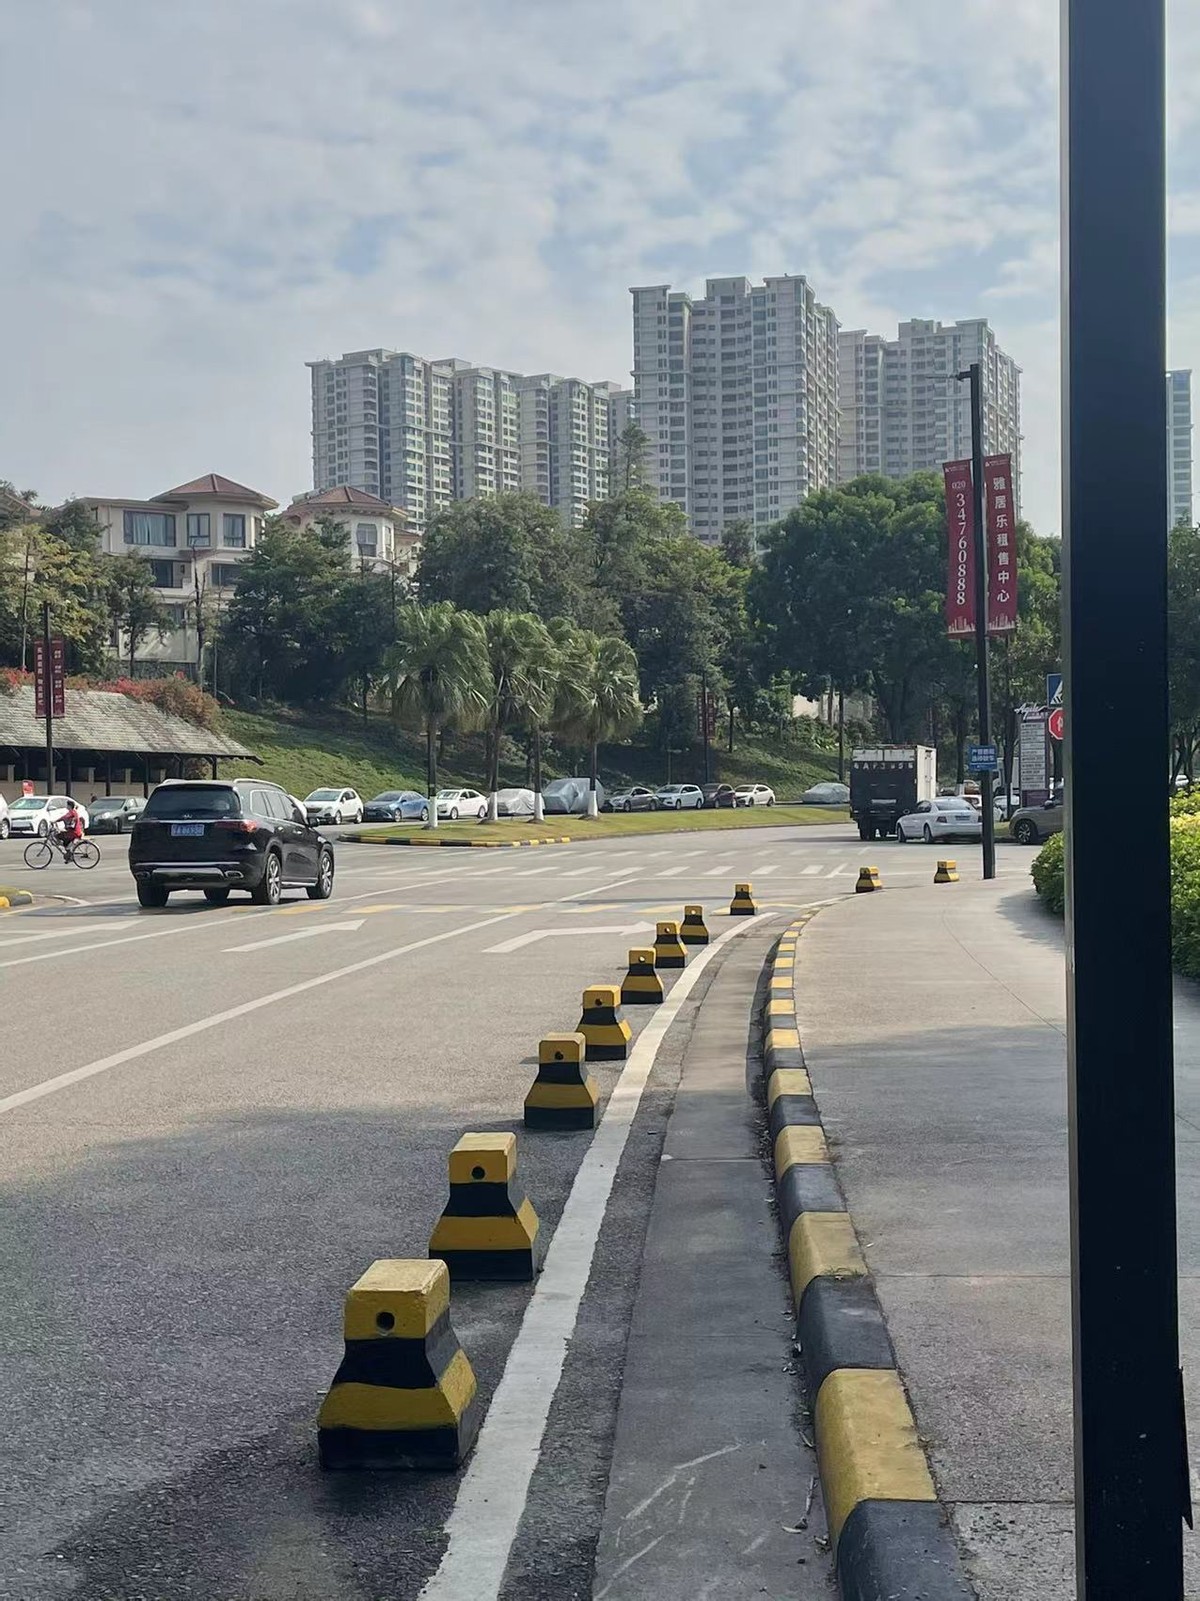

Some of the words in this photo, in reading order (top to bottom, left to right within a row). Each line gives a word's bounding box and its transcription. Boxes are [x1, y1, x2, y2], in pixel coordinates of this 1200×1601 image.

[952, 480, 967, 489] 020
[993, 476, 1010, 602] 雅居乐租售中心
[956, 493, 967, 605] 34760888
